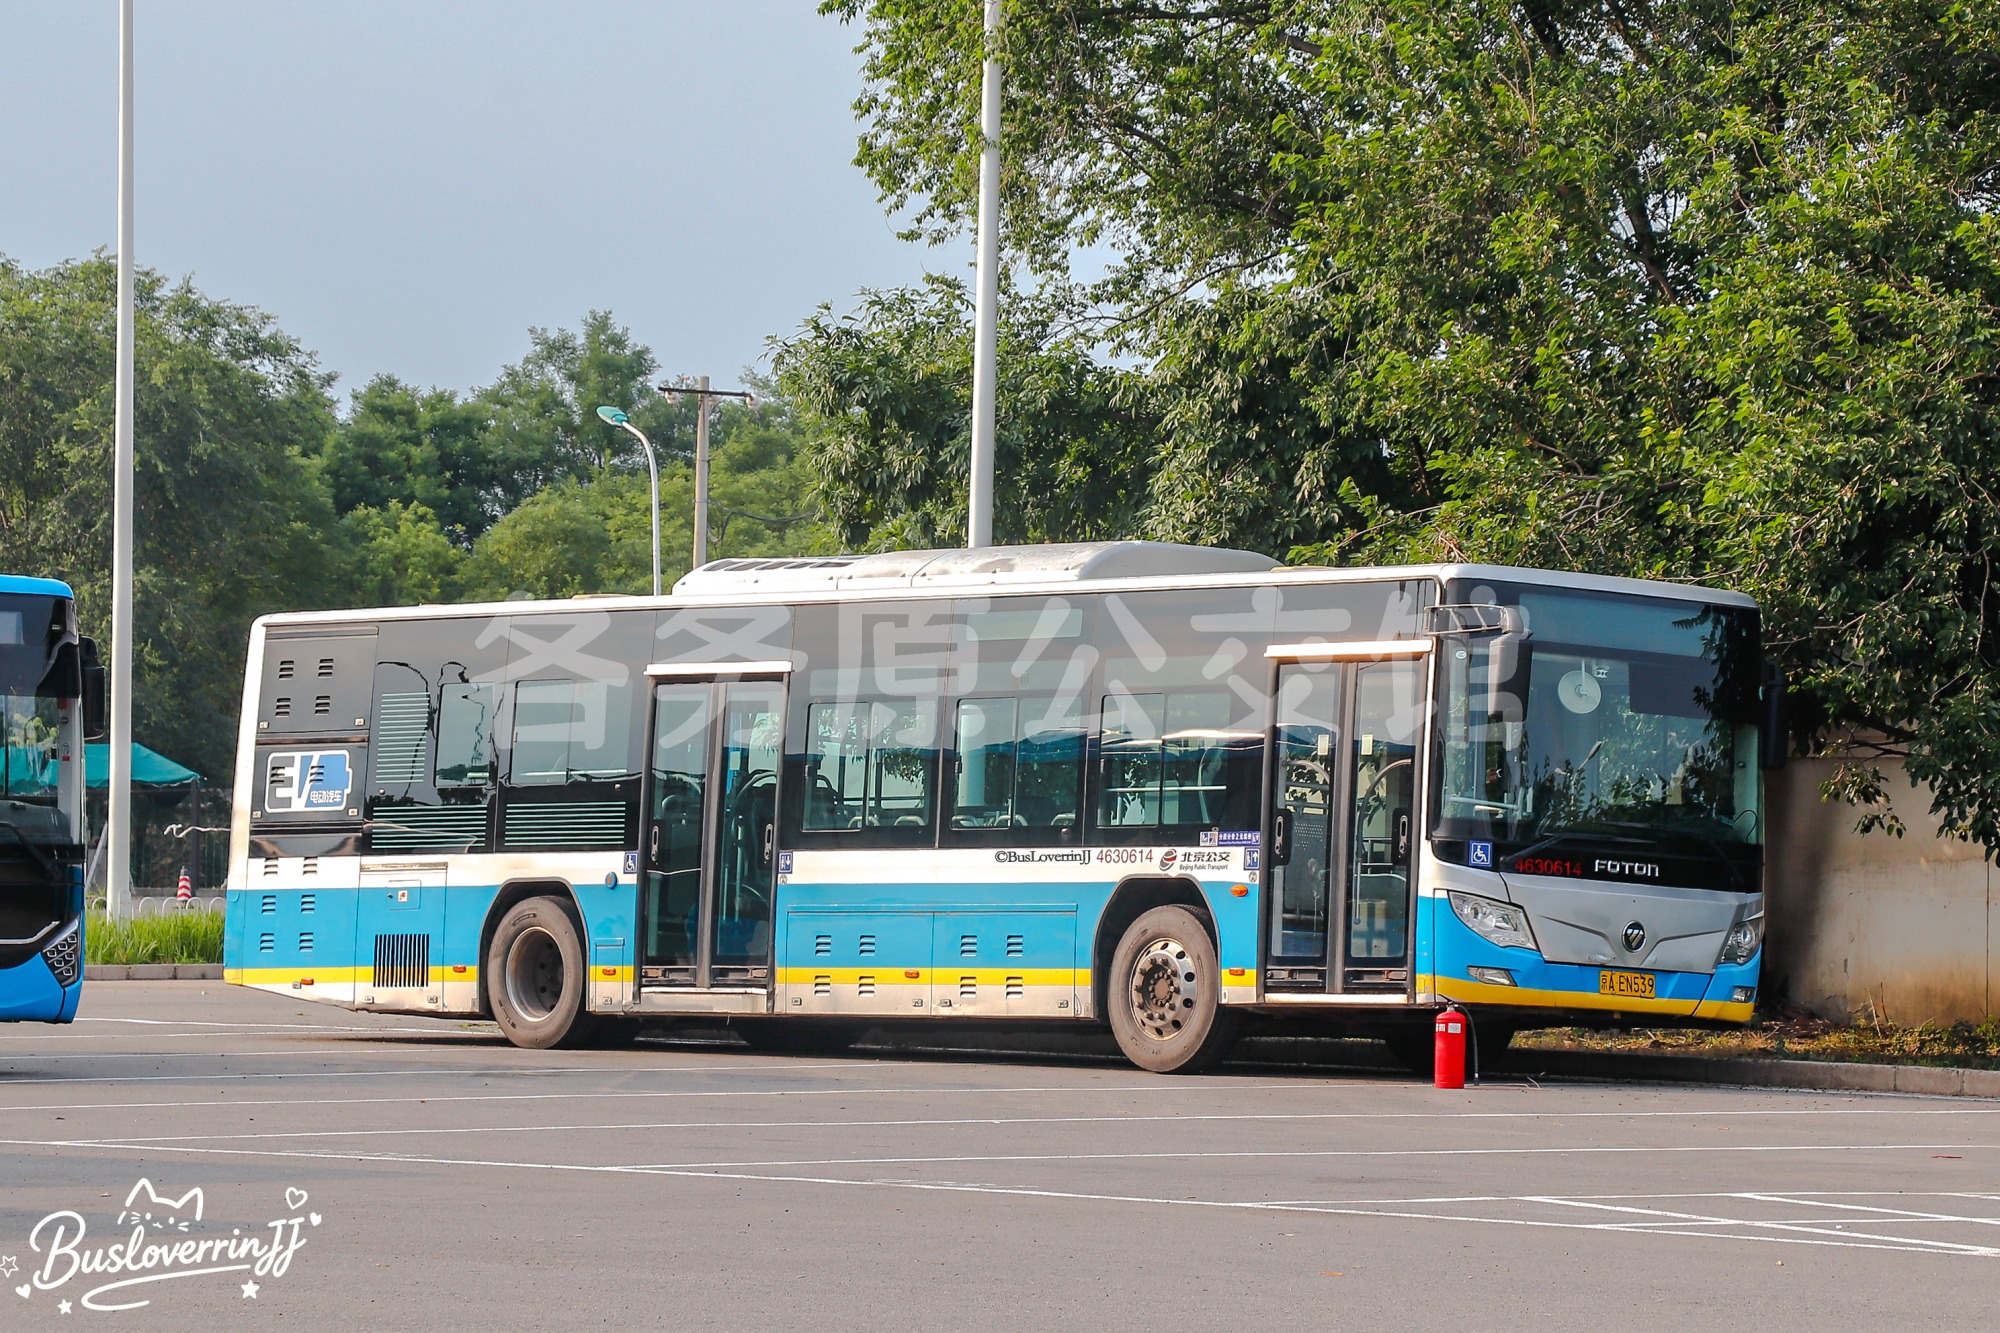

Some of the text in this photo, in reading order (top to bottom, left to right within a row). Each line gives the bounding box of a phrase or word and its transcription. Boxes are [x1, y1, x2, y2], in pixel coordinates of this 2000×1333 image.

[310, 790, 342, 803] 电动汽车
[1096, 848, 1154, 864] 4630614
[1180, 851, 1231, 862] 北京公交
[1515, 857, 1582, 876] 4630614
[1594, 859, 1660, 877] FOTON
